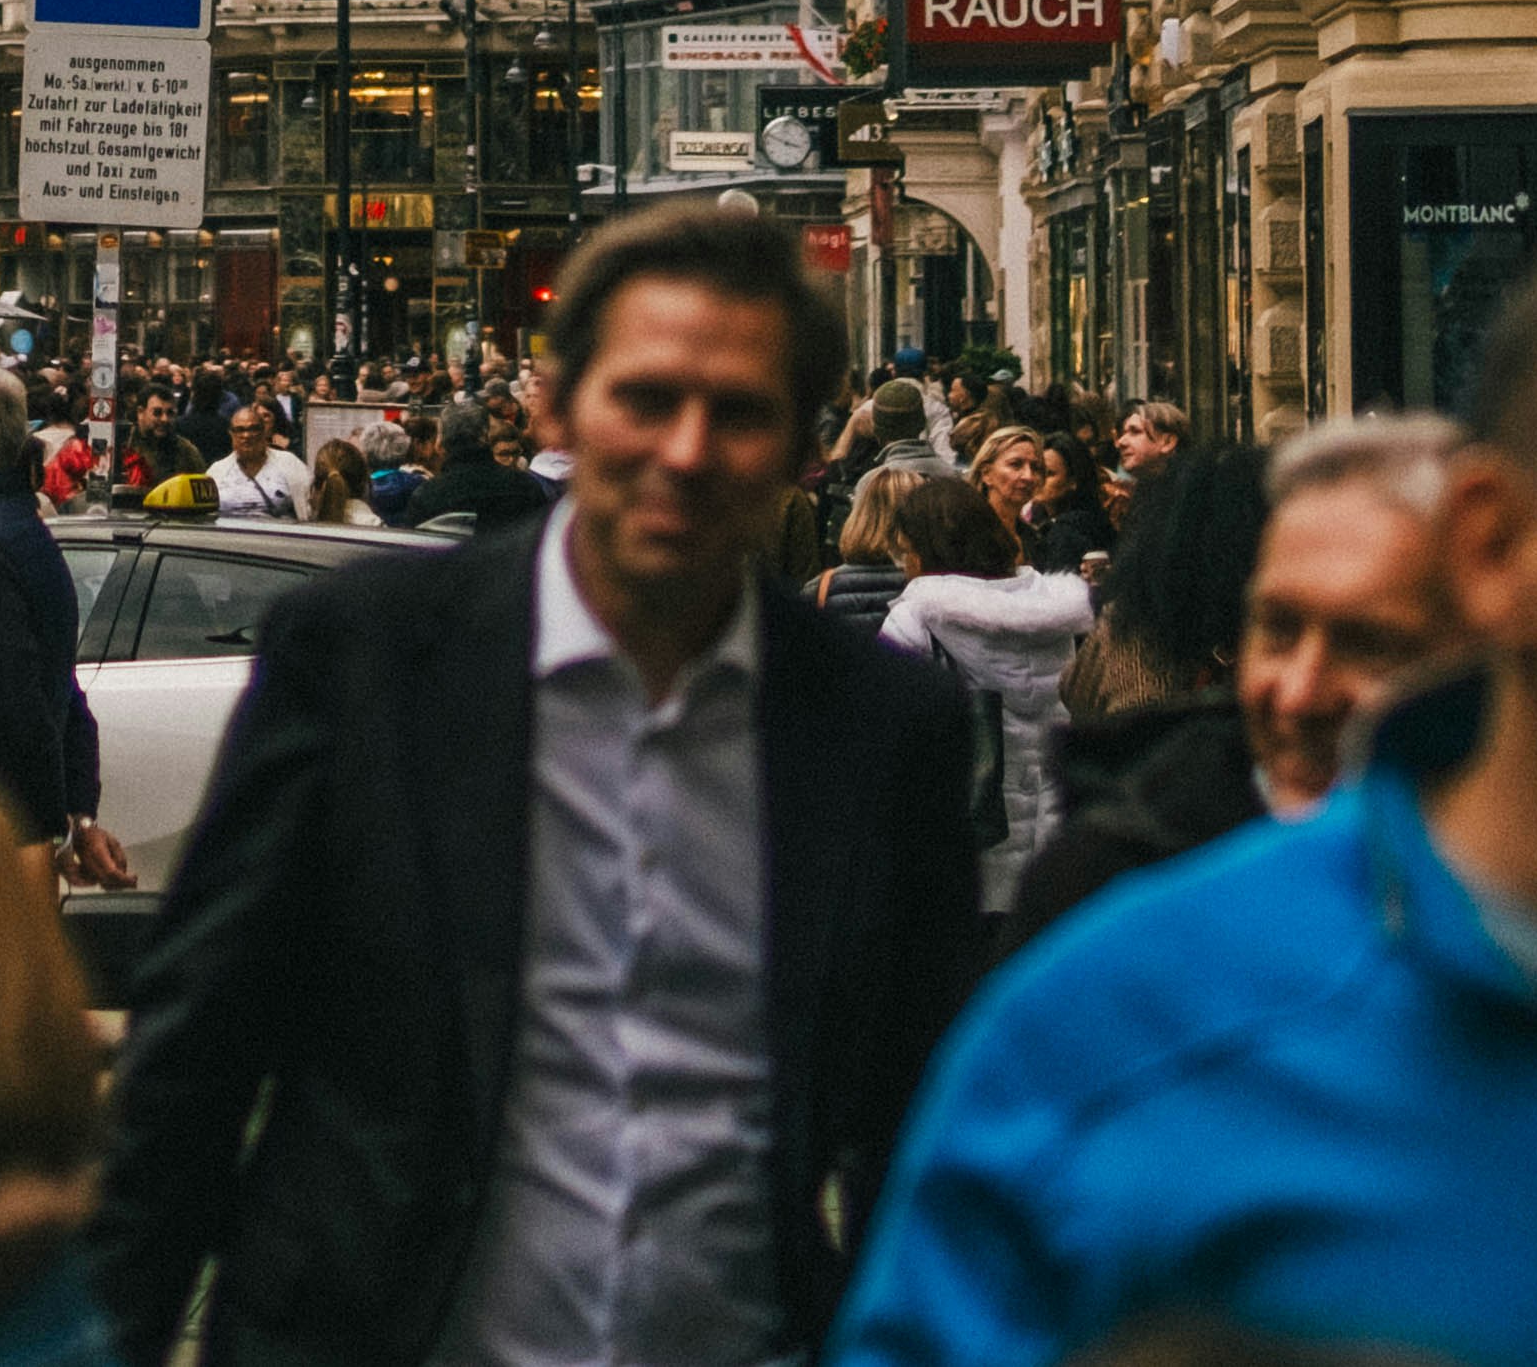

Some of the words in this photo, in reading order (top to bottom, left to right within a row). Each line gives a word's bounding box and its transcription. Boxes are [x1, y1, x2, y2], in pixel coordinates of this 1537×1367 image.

[69, 57, 165, 73] ausgenommen
[28, 94, 77, 110] Zufahrt
[85, 101, 106, 113] zur
[113, 99, 202, 119] Ladetätigkeit
[40, 119, 61, 132] mit
[67, 118, 137, 139] Fahrzeuge
[144, 122, 163, 137] bis
[170, 123, 188, 138] 18t
[25, 138, 95, 156] höchstzul.
[98, 141, 200, 162] Gesamtgewicht
[66, 163, 90, 177] und
[97, 162, 123, 177] Taxi
[130, 167, 157, 180] zum
[43, 181, 73, 197] Aus-
[79, 185, 103, 199] und
[109, 185, 179, 205] Einsteigen
[1403, 204, 1515, 223] MONTBLANC
